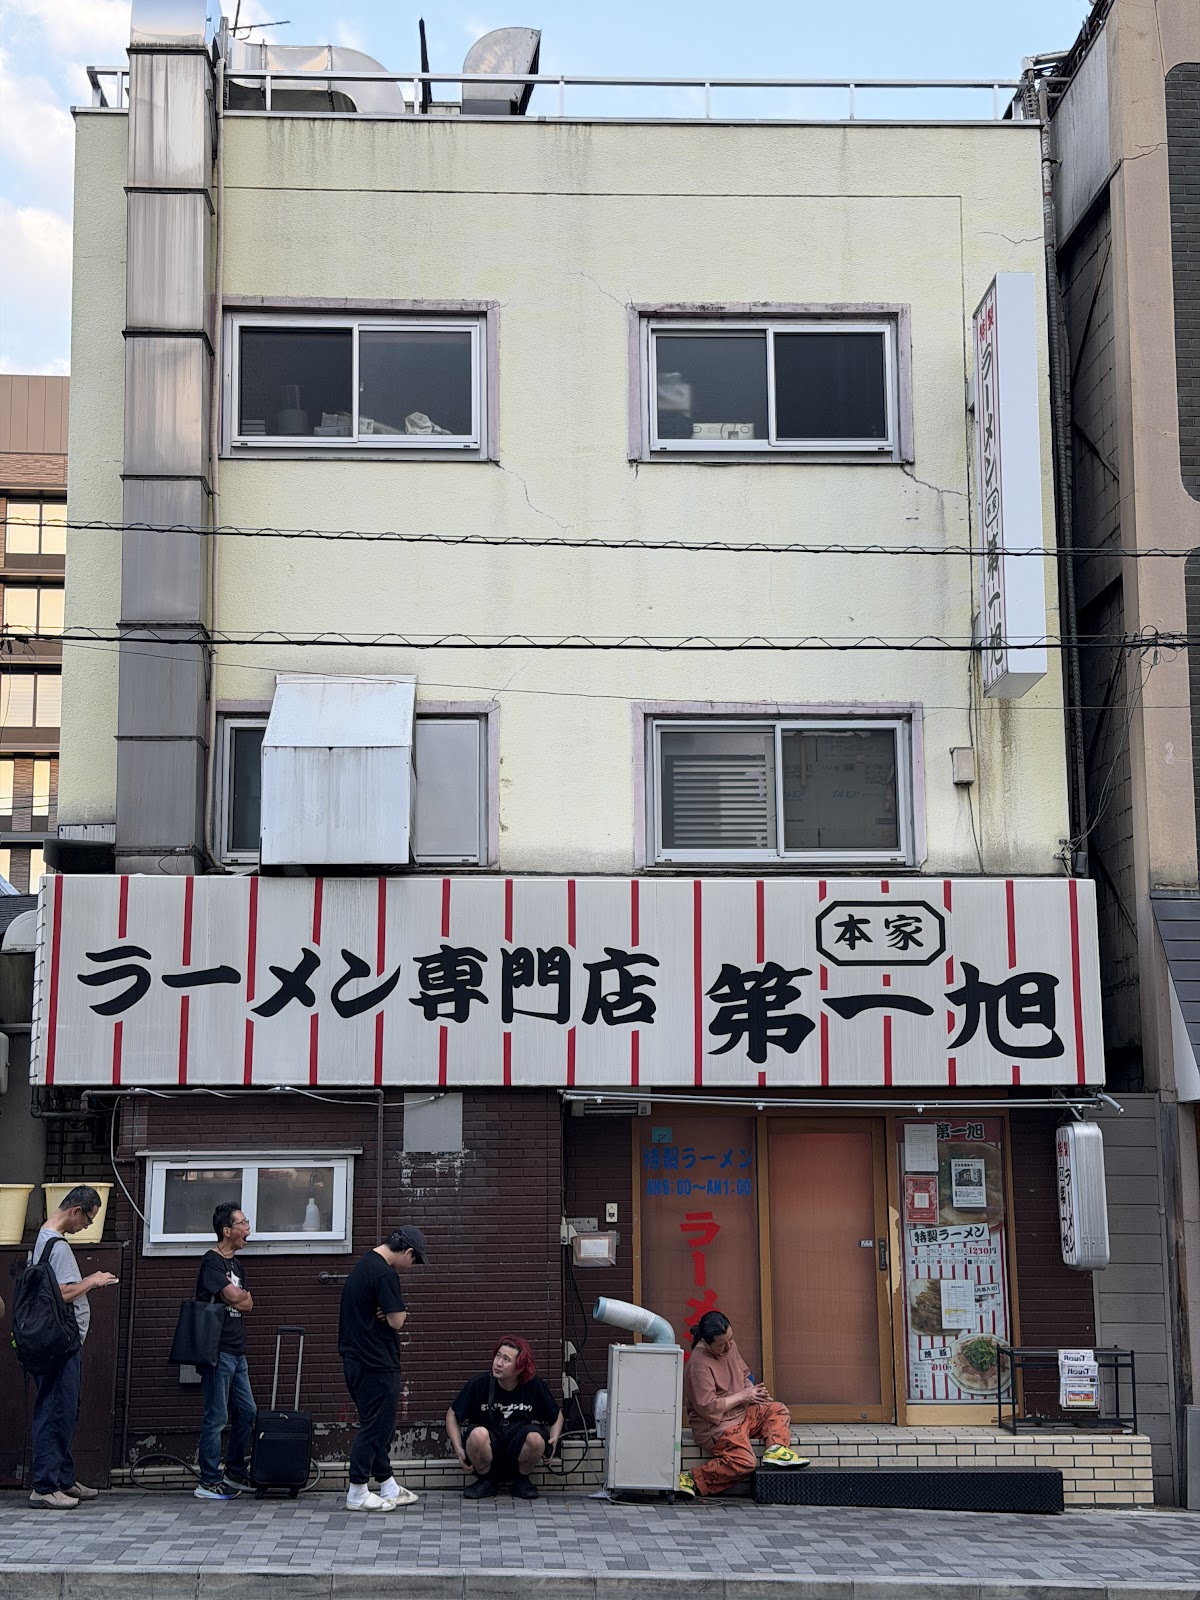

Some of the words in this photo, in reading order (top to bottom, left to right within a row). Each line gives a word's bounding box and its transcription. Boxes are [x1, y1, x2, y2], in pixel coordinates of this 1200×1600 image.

[981, 342, 996, 489] ラーメン
[987, 531, 1003, 669] 第一旭
[833, 914, 924, 951] 本家
[77, 944, 660, 1026] ラーメン専門店
[705, 961, 1065, 1064] 第一旭
[643, 1147, 753, 1170] 特製ラーメン
[914, 1226, 985, 1244] 特製ラーメン
